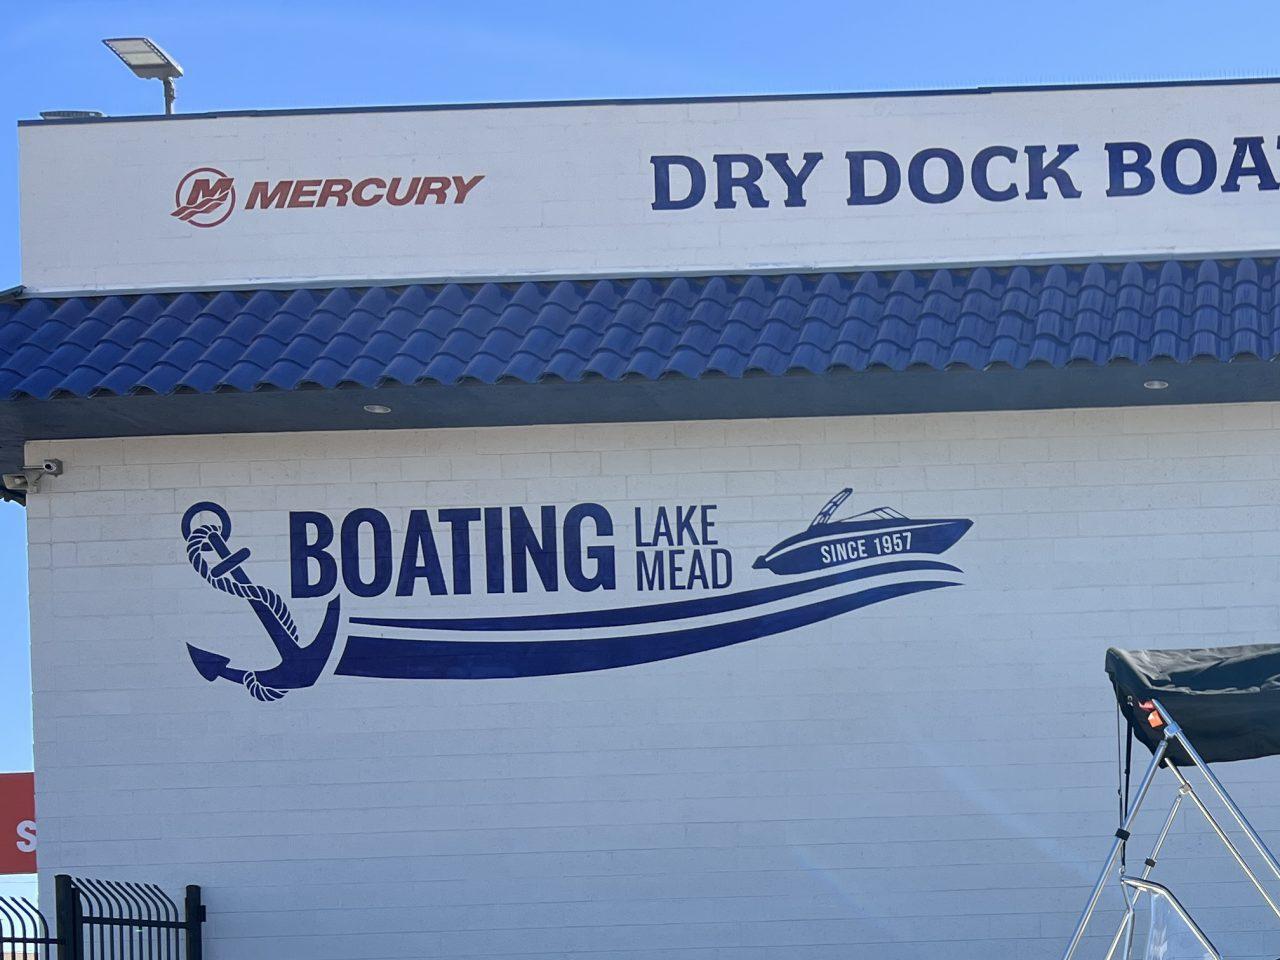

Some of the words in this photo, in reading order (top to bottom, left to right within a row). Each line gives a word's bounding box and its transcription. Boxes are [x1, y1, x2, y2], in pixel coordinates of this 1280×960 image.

[244, 175, 486, 210] MERCURY
[649, 151, 824, 211] DRY
[845, 143, 1082, 206] DOCK
[289, 502, 616, 598] BOATING
[634, 504, 718, 547] LAKE
[820, 539, 868, 564] SINCE
[874, 531, 912, 555] 1957
[635, 548, 733, 592] MEAD
